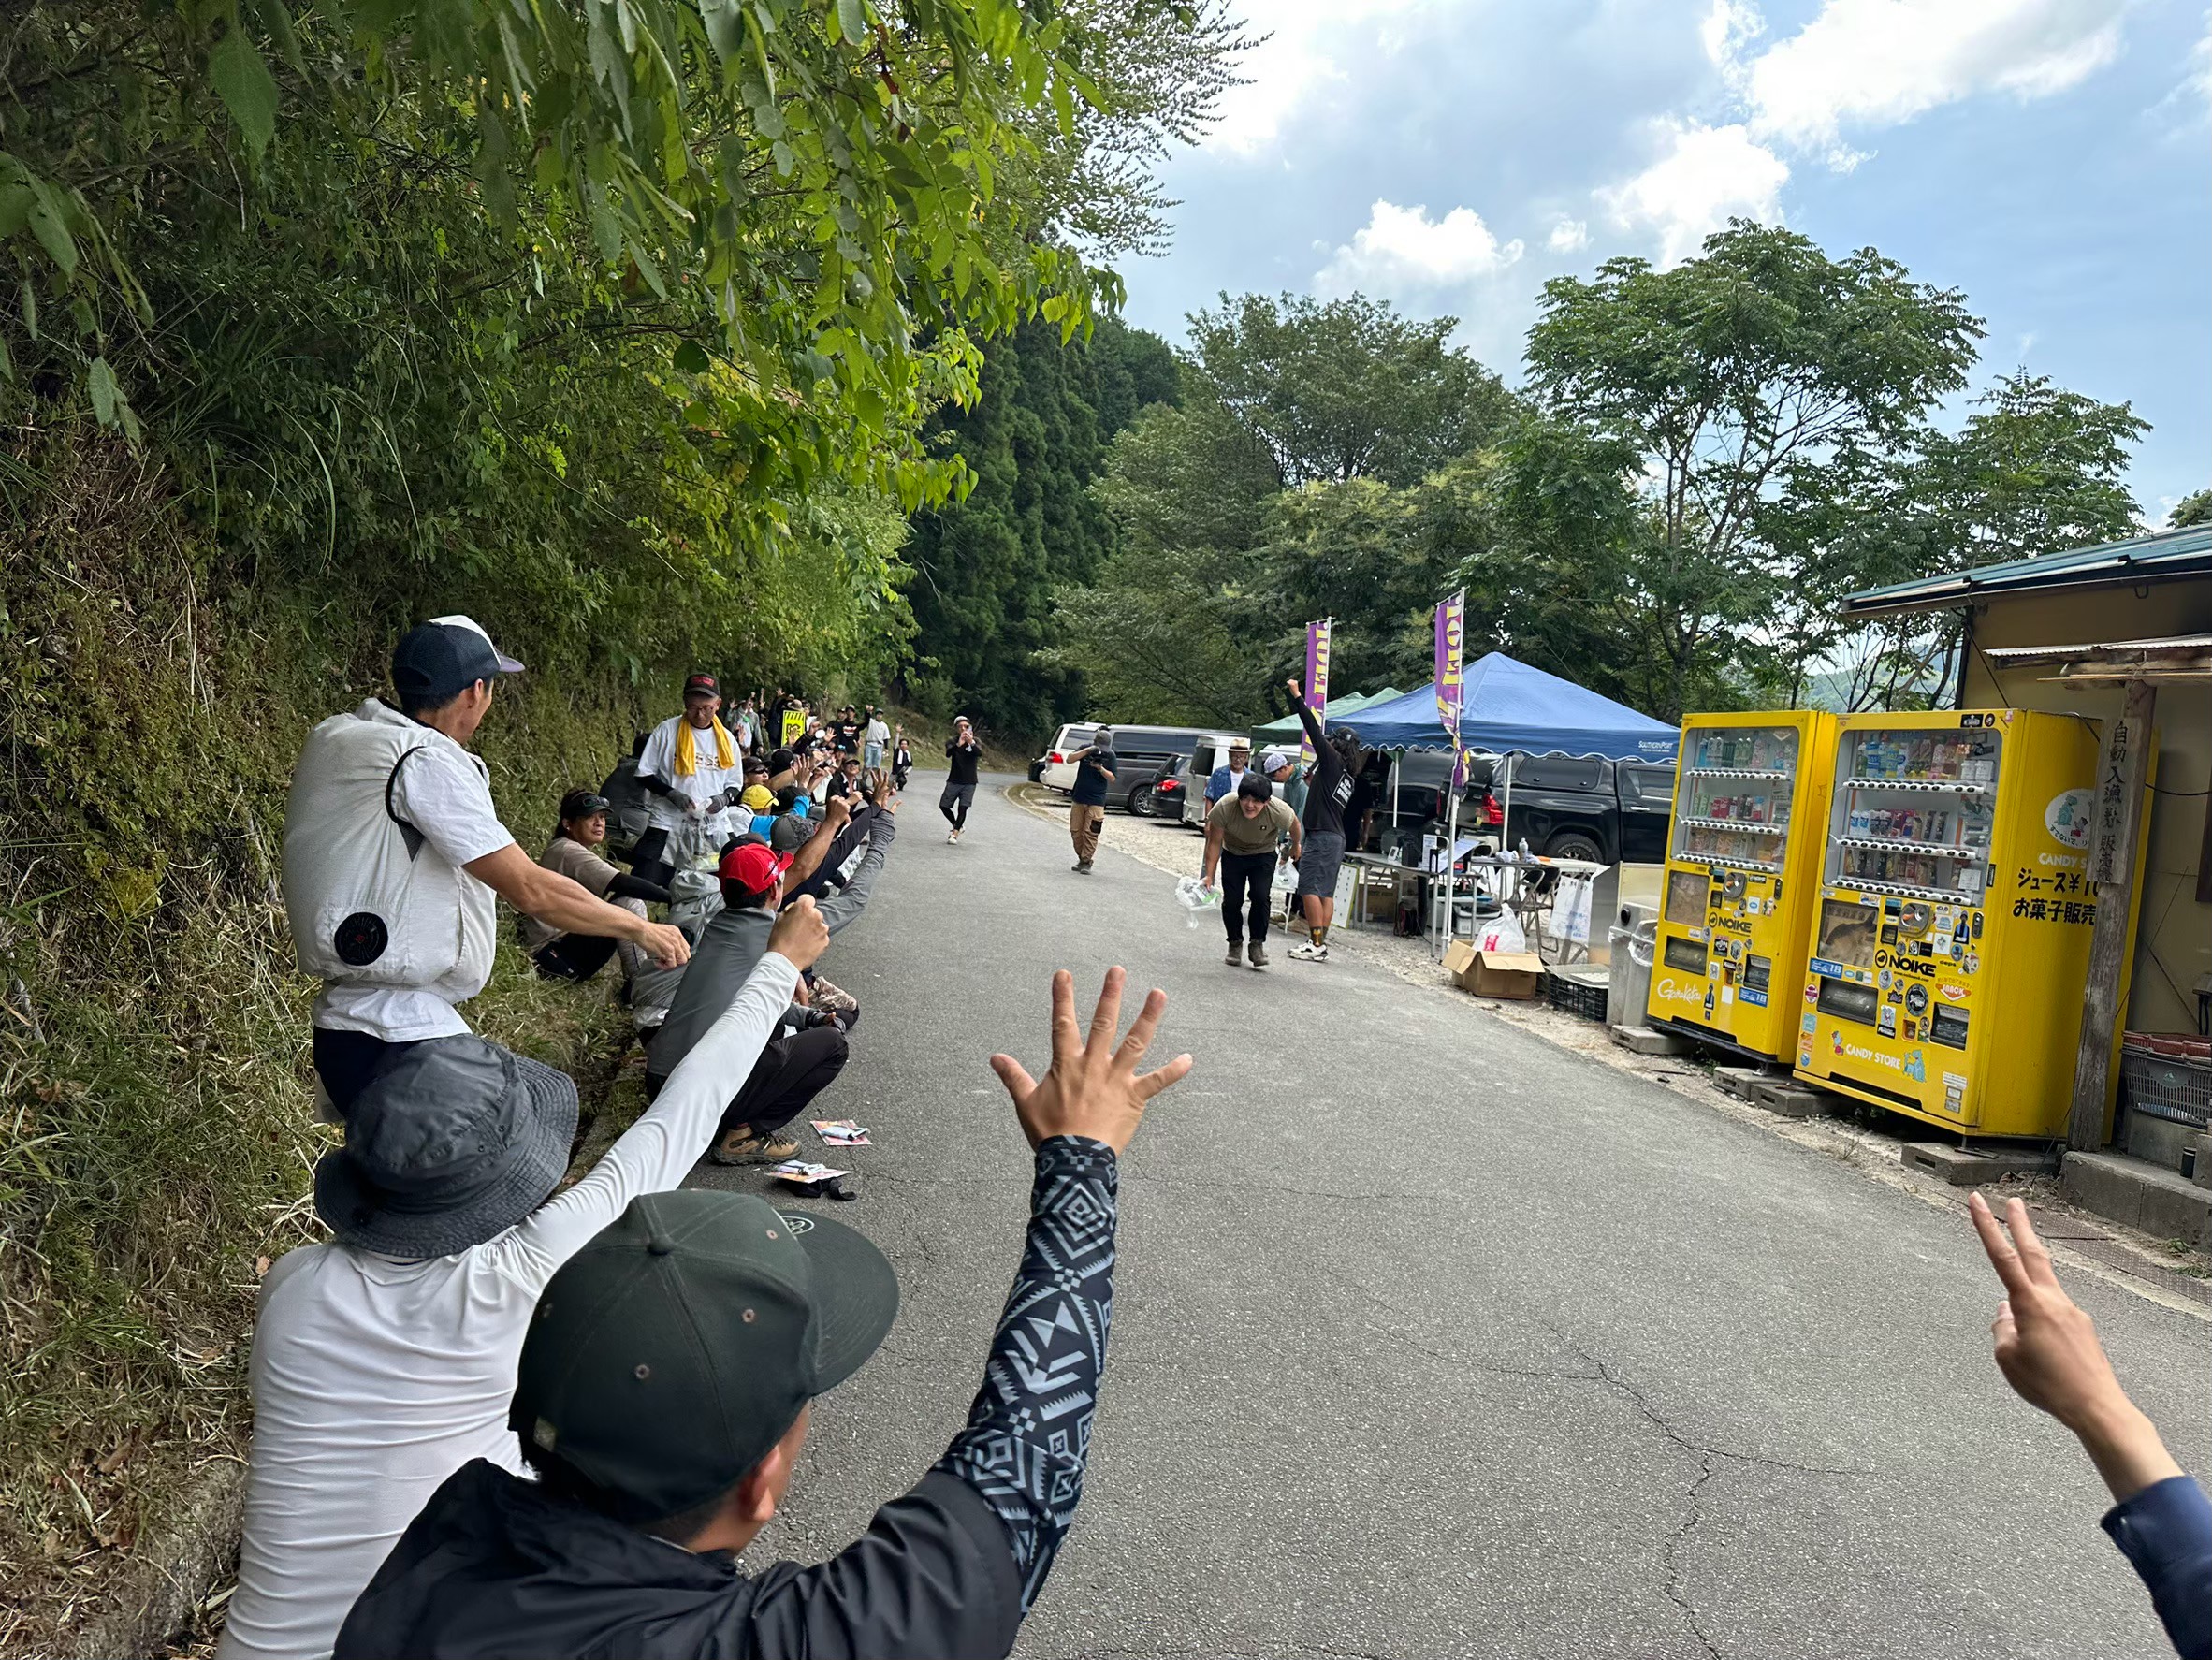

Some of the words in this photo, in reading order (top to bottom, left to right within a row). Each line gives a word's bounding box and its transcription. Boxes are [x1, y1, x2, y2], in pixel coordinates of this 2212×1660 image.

[2039, 852, 2078, 868] CANDY
[1718, 917, 1752, 933] NOIKE
[1889, 955, 1936, 978] NOIKE
[1845, 1043, 1873, 1061] CANDY
[1874, 1053, 1901, 1070] STORE
